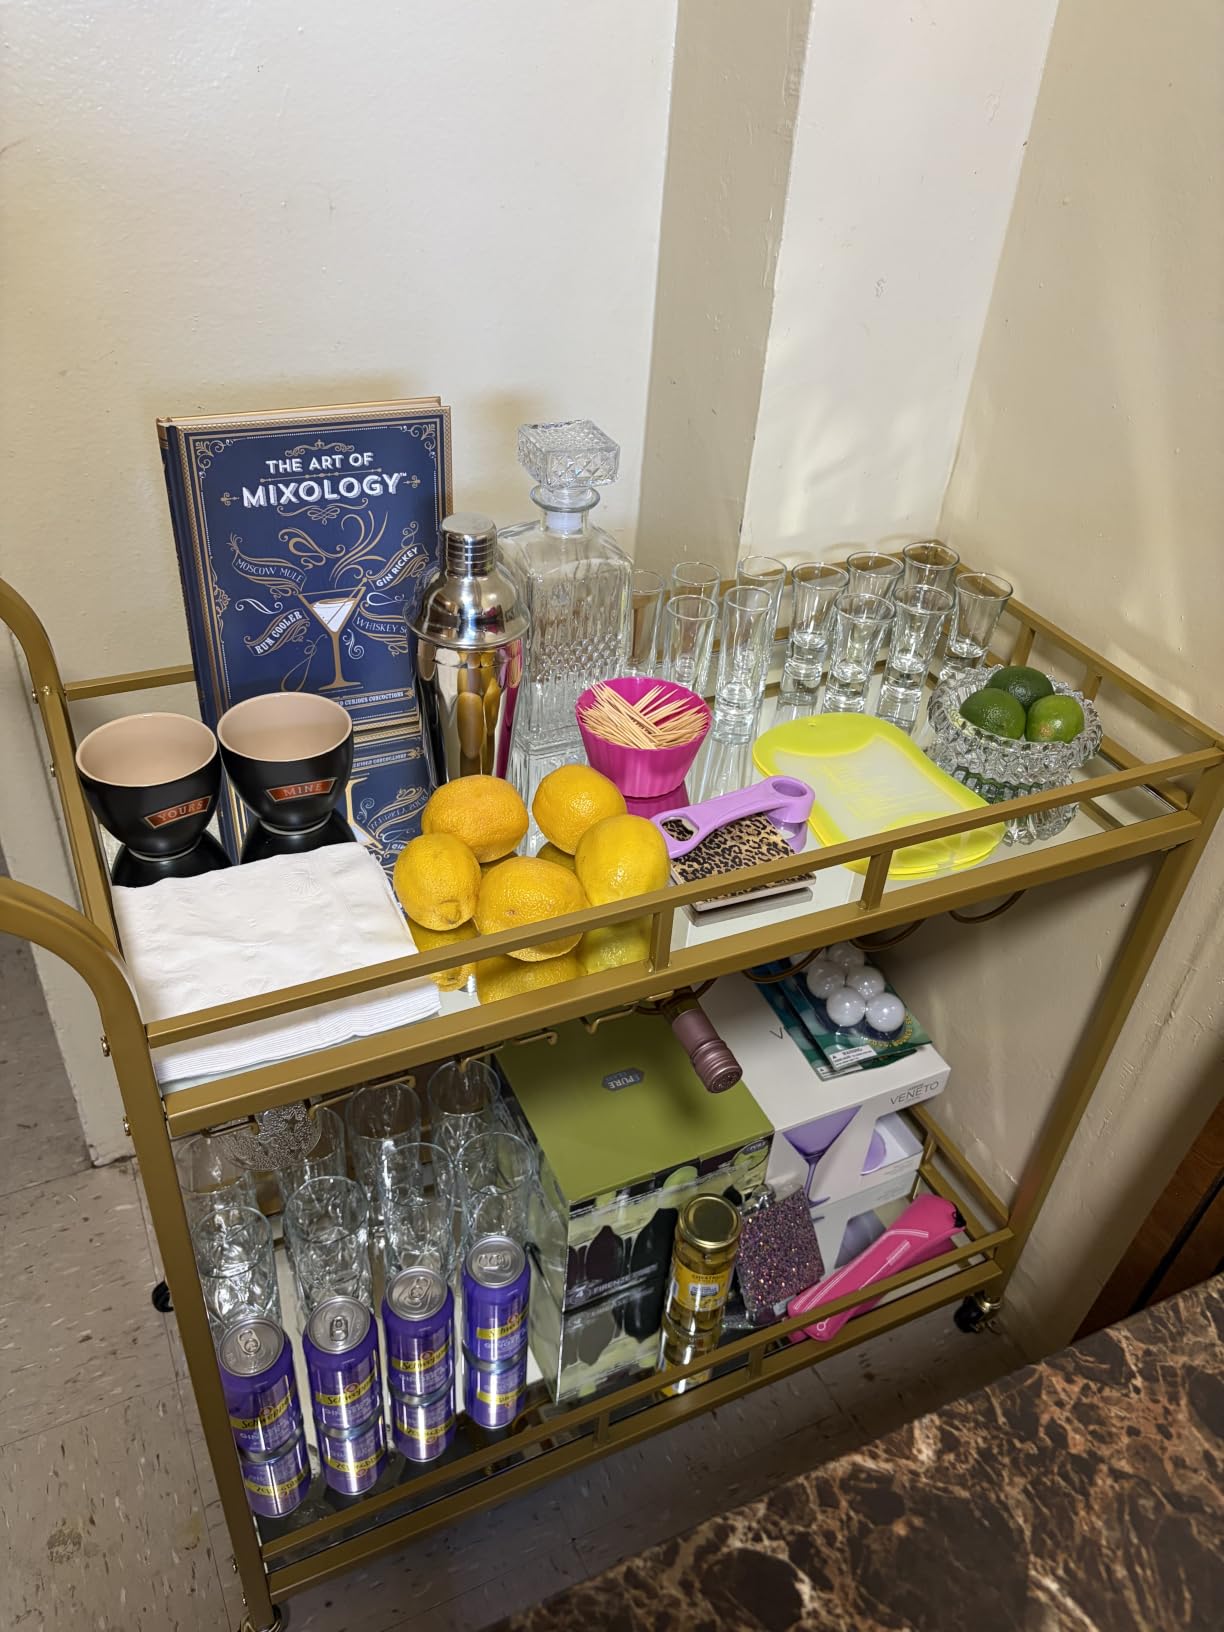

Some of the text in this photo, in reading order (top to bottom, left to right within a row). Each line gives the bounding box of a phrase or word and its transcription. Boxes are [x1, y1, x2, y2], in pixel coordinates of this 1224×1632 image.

[265, 451, 375, 475] THE ART OF
[241, 472, 402, 508] MIXOLOGY
[235, 558, 304, 583] MOSCOW MULE
[375, 546, 419, 587] GIN RICKEY
[254, 610, 303, 654] RUM COOLER
[356, 616, 399, 633] WHISKEY
[282, 783, 323, 797] MINE
[157, 800, 204, 822] YOURS
[607, 1075, 635, 1089] PURE
[889, 1080, 940, 1105] VENETO
